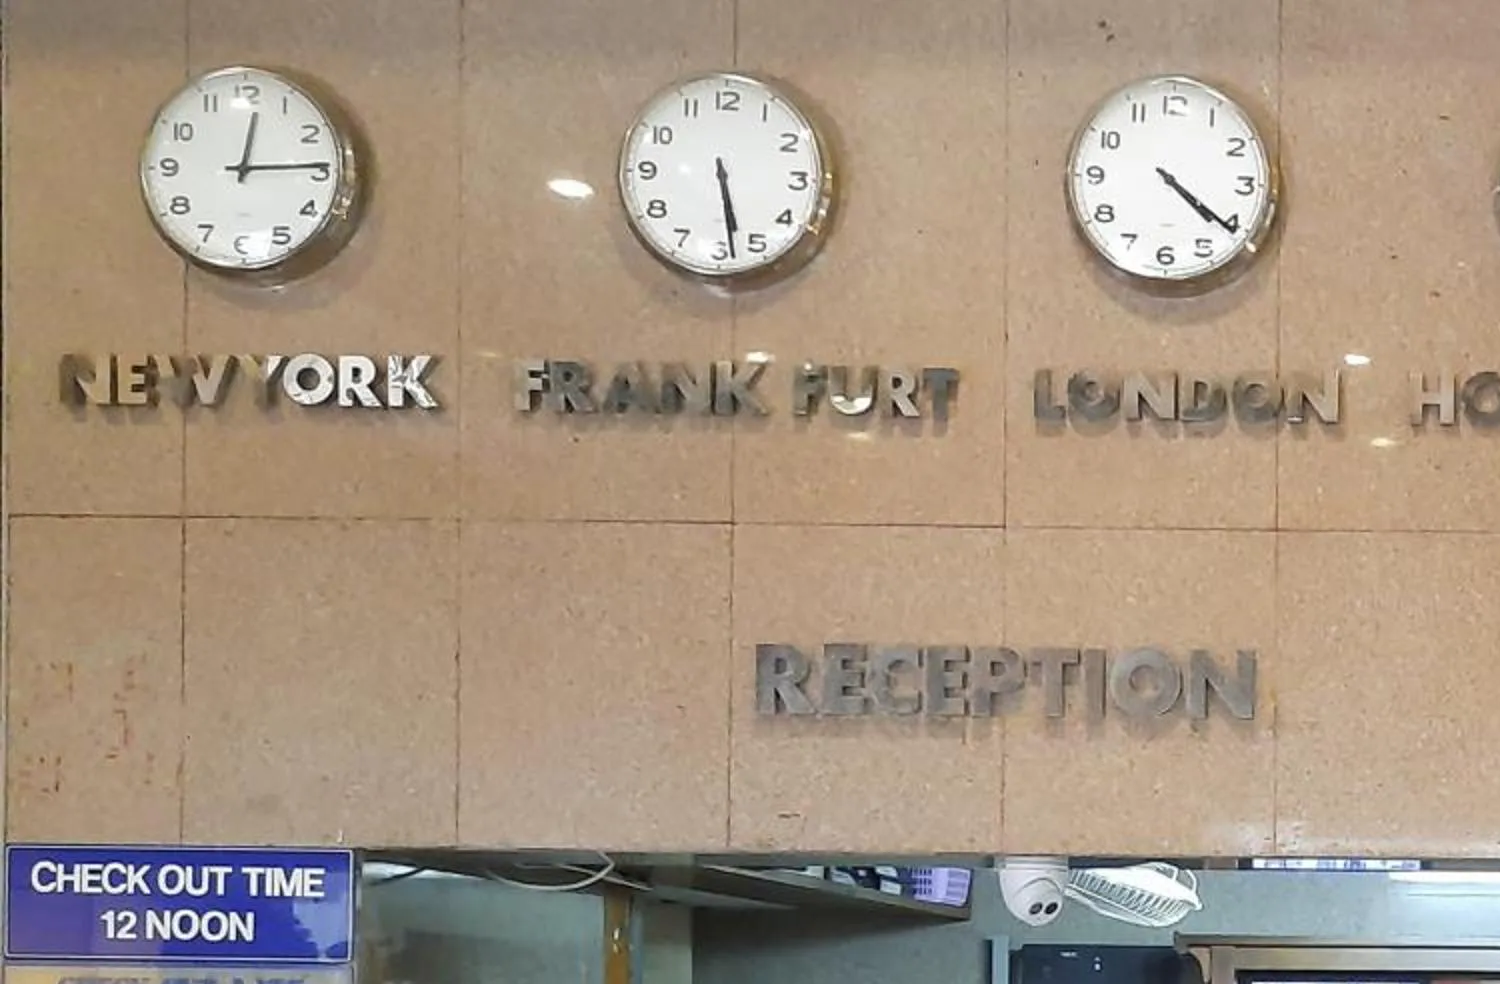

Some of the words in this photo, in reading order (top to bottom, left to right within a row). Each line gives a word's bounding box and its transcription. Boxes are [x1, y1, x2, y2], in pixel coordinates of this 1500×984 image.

[203, 94, 218, 112] 11
[282, 96, 287, 114] 1
[684, 98, 698, 117] 11
[715, 91, 740, 111] 12
[762, 104, 767, 122] 1
[1132, 103, 1145, 123] 11
[1210, 107, 1214, 127] 1
[173, 123, 193, 141] 10
[301, 125, 320, 143] 2
[652, 126, 672, 144] 10
[1101, 131, 1120, 150] 10
[780, 133, 798, 153] 2
[1226, 138, 1245, 157] 2
[160, 158, 179, 176] 9
[638, 161, 657, 180] 9
[1086, 166, 1104, 184] 9
[788, 171, 808, 191] 3
[1235, 176, 1254, 195] 3
[170, 196, 190, 214] 8
[300, 200, 318, 217] 4
[646, 200, 667, 218] 8
[1094, 204, 1114, 223] 8
[775, 209, 792, 225] 4
[198, 224, 214, 243] 7
[272, 226, 291, 245] 5
[673, 228, 690, 248] 7
[748, 233, 767, 253] 5
[1156, 246, 1175, 265] 6
[1194, 238, 1213, 258] 5
[514, 359, 772, 414] FRANK
[792, 364, 960, 420] FURT
[1033, 368, 1343, 426] LONDON
[754, 642, 1258, 719] RECEPTION
[31, 861, 150, 895] CHECK
[157, 865, 232, 897] OUT
[242, 867, 326, 898] TIME
[101, 911, 137, 939] 12
[145, 910, 255, 941] NOON
